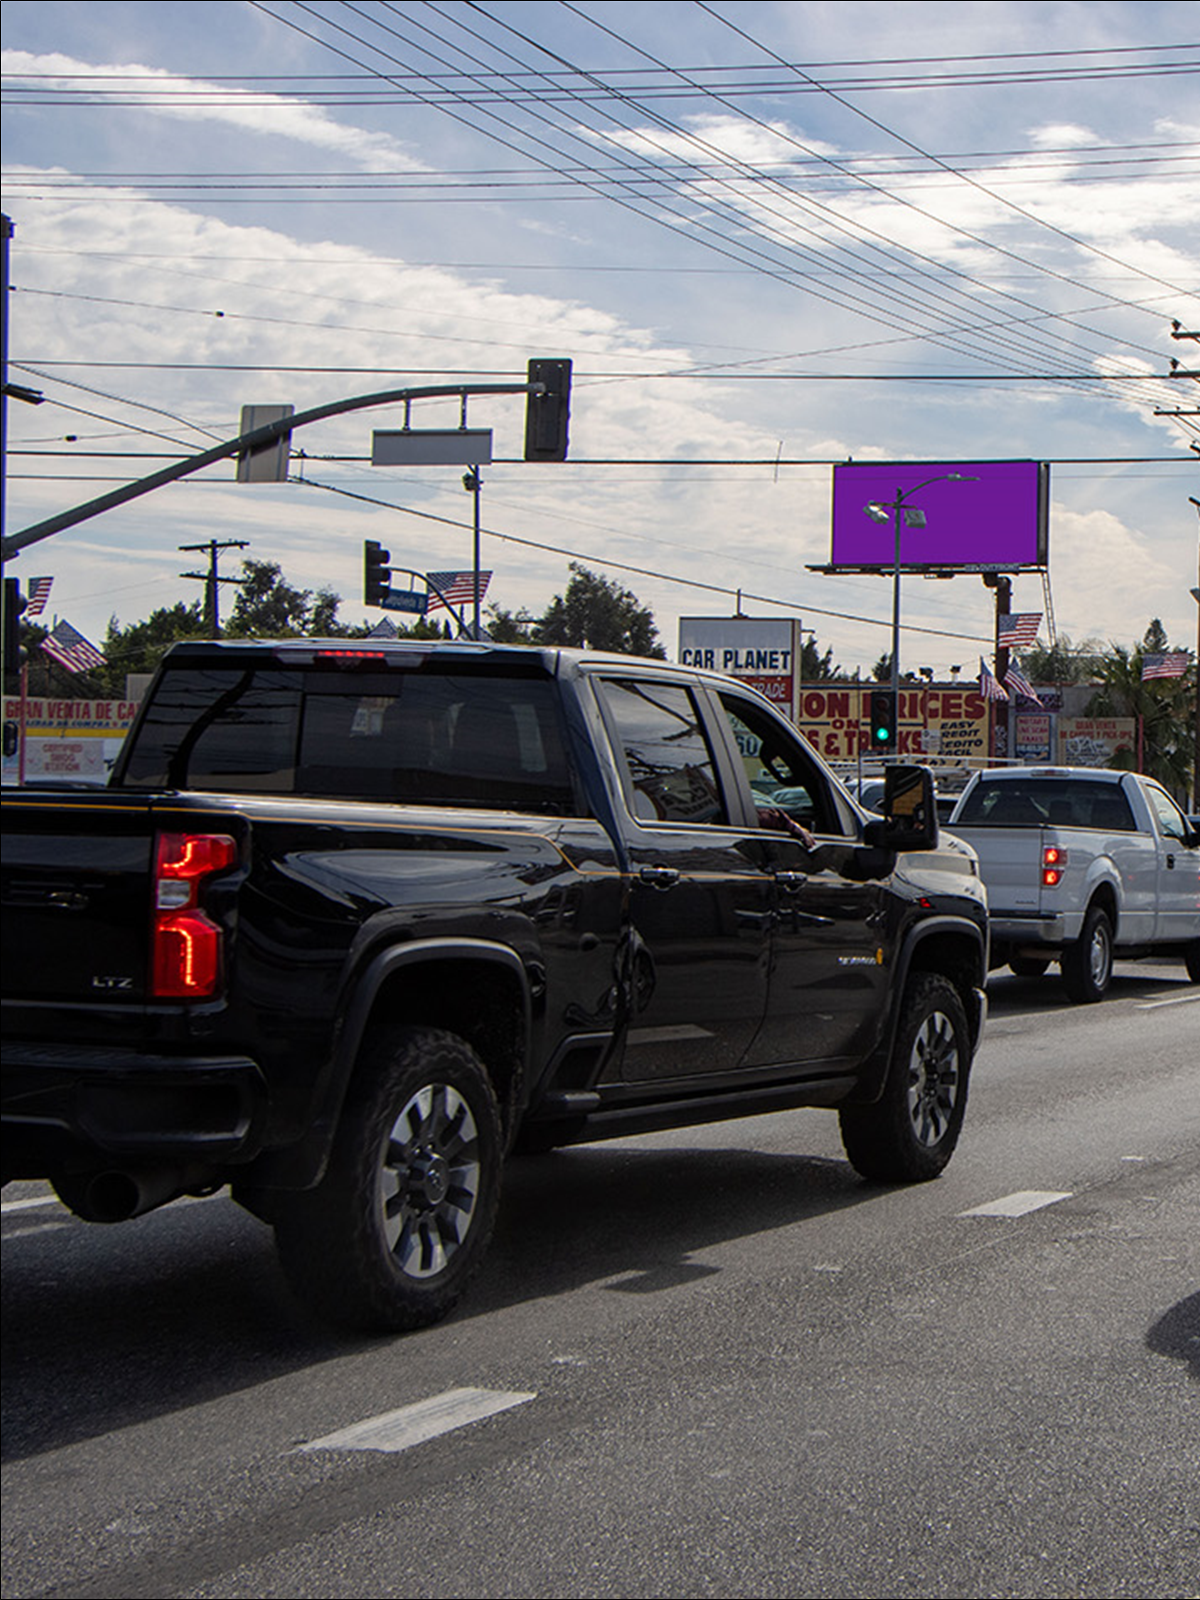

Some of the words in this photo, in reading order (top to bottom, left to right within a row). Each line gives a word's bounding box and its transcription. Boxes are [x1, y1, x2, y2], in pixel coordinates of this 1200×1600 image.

[682, 648, 715, 669] CAR
[723, 650, 791, 669] PLANET
[47, 701, 91, 719] VENTA
[95, 701, 112, 719] DE
[117, 701, 142, 719] CA
[831, 718, 860, 729] ON
[941, 720, 975, 730] EASY
[941, 728, 981, 738] REDIT
[824, 733, 841, 755] &
[92, 975, 132, 989] LTZ
